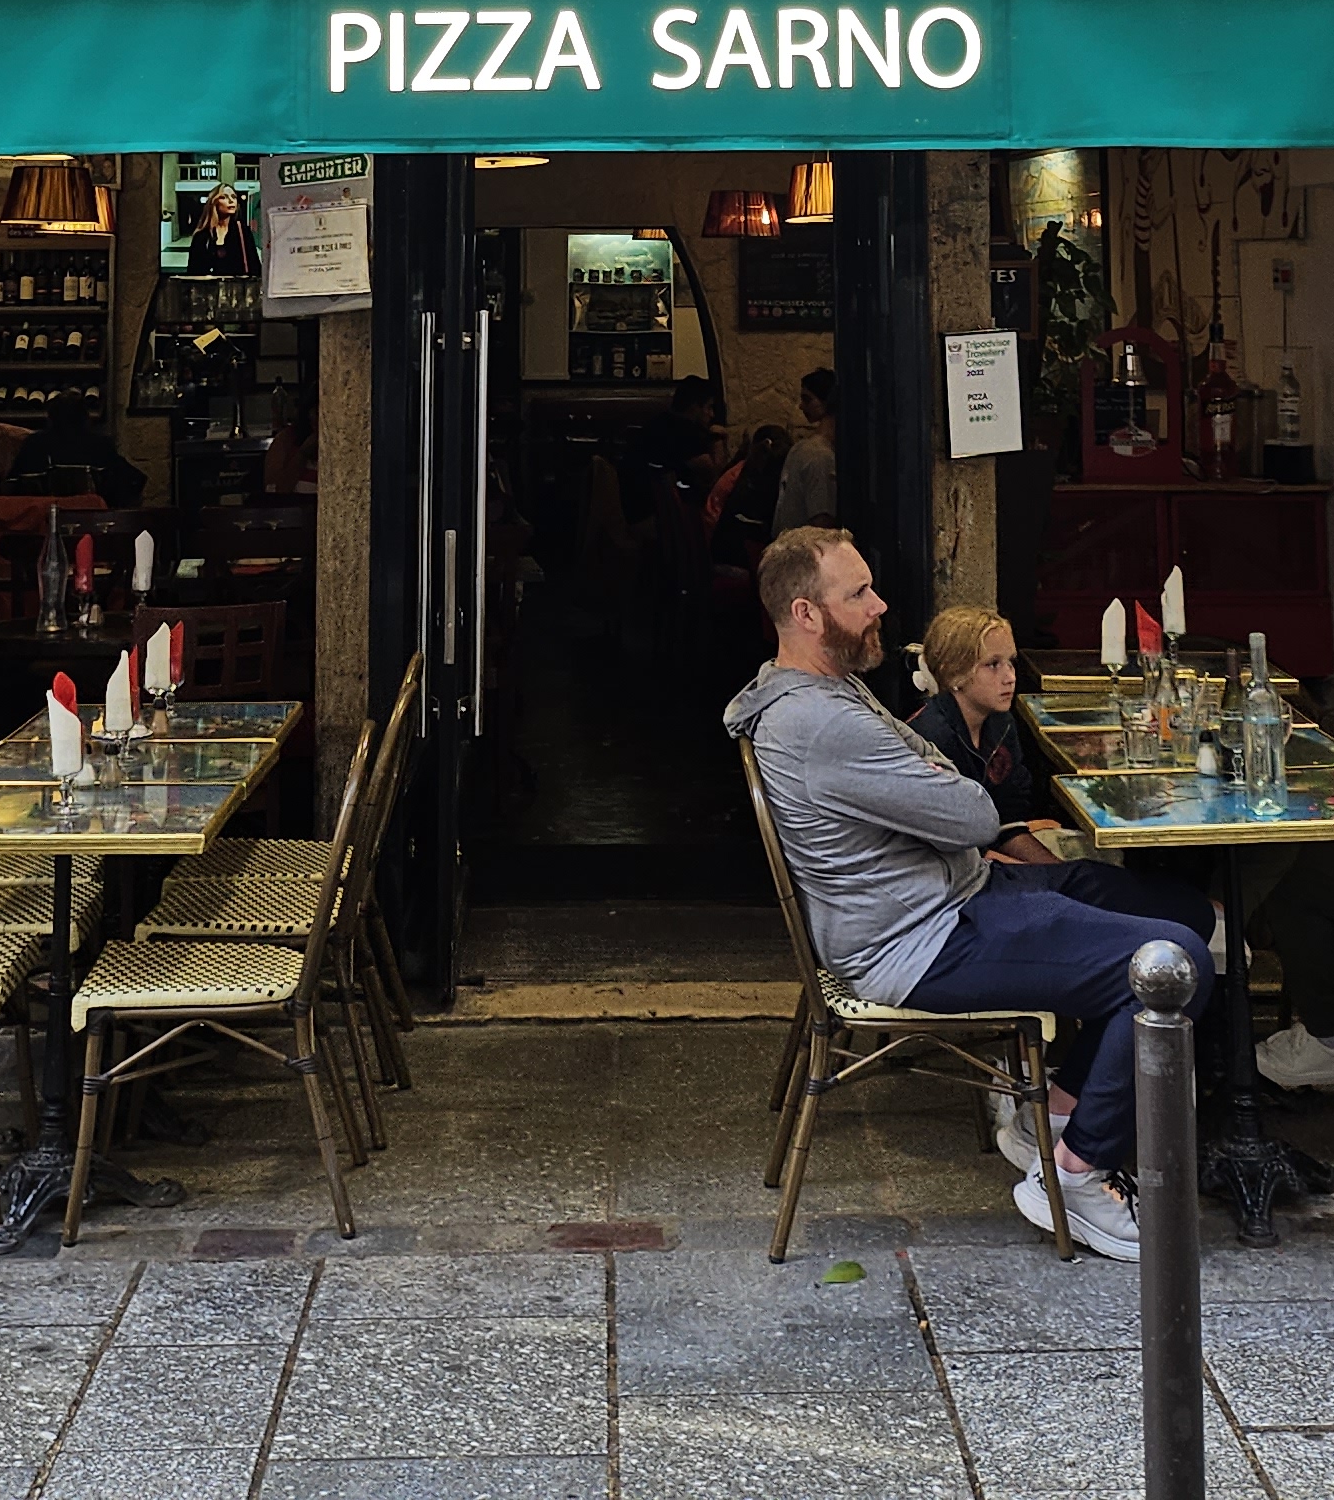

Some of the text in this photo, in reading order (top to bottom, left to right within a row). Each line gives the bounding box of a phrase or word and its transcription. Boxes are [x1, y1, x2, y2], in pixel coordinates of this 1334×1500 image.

[329, 7, 982, 92] PIZZA SARNO
[283, 156, 363, 183] EMPORTER
[967, 393, 988, 401] PIZZA
